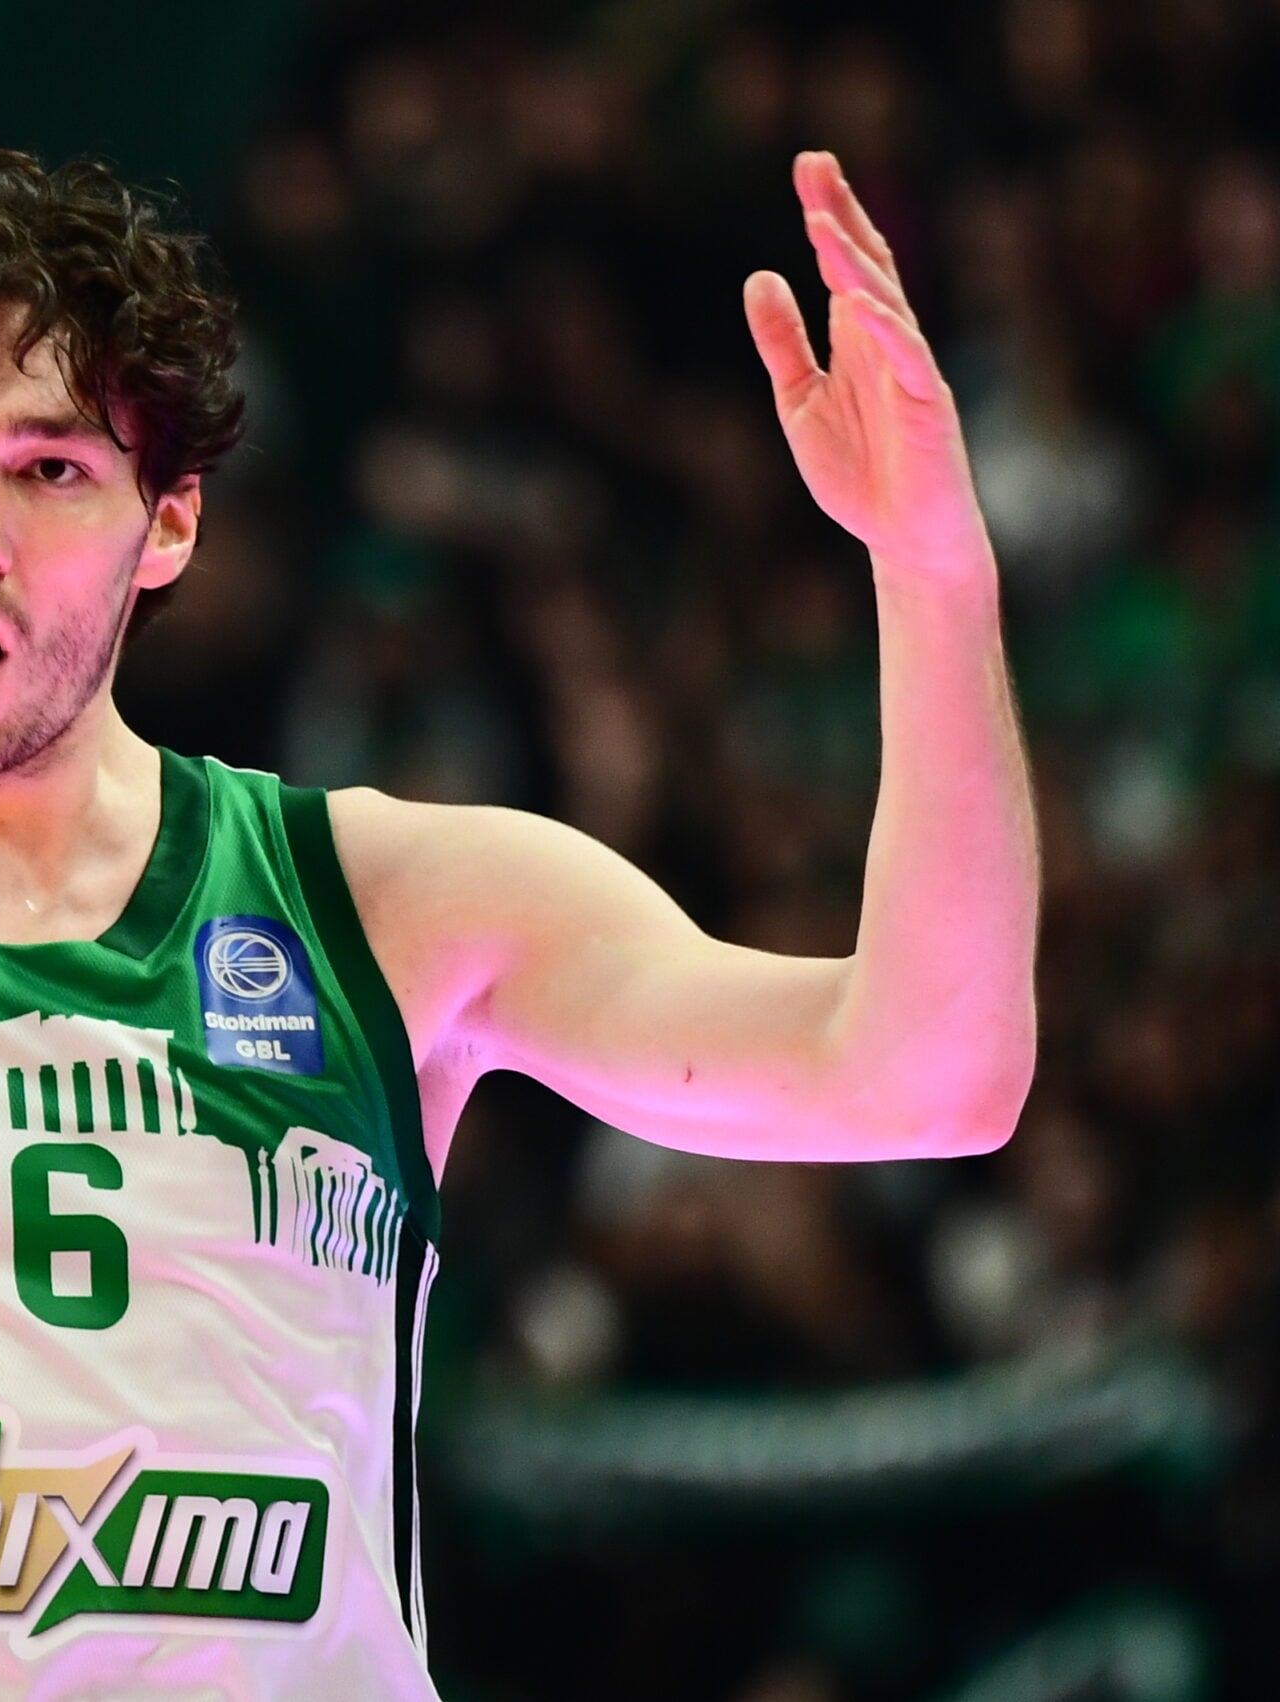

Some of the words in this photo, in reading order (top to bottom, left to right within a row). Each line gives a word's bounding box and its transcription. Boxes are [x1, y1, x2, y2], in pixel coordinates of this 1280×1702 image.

[204, 1011, 316, 1031] Stoiximan
[235, 1039, 291, 1061] GBL
[11, 1143, 129, 1330] 6
